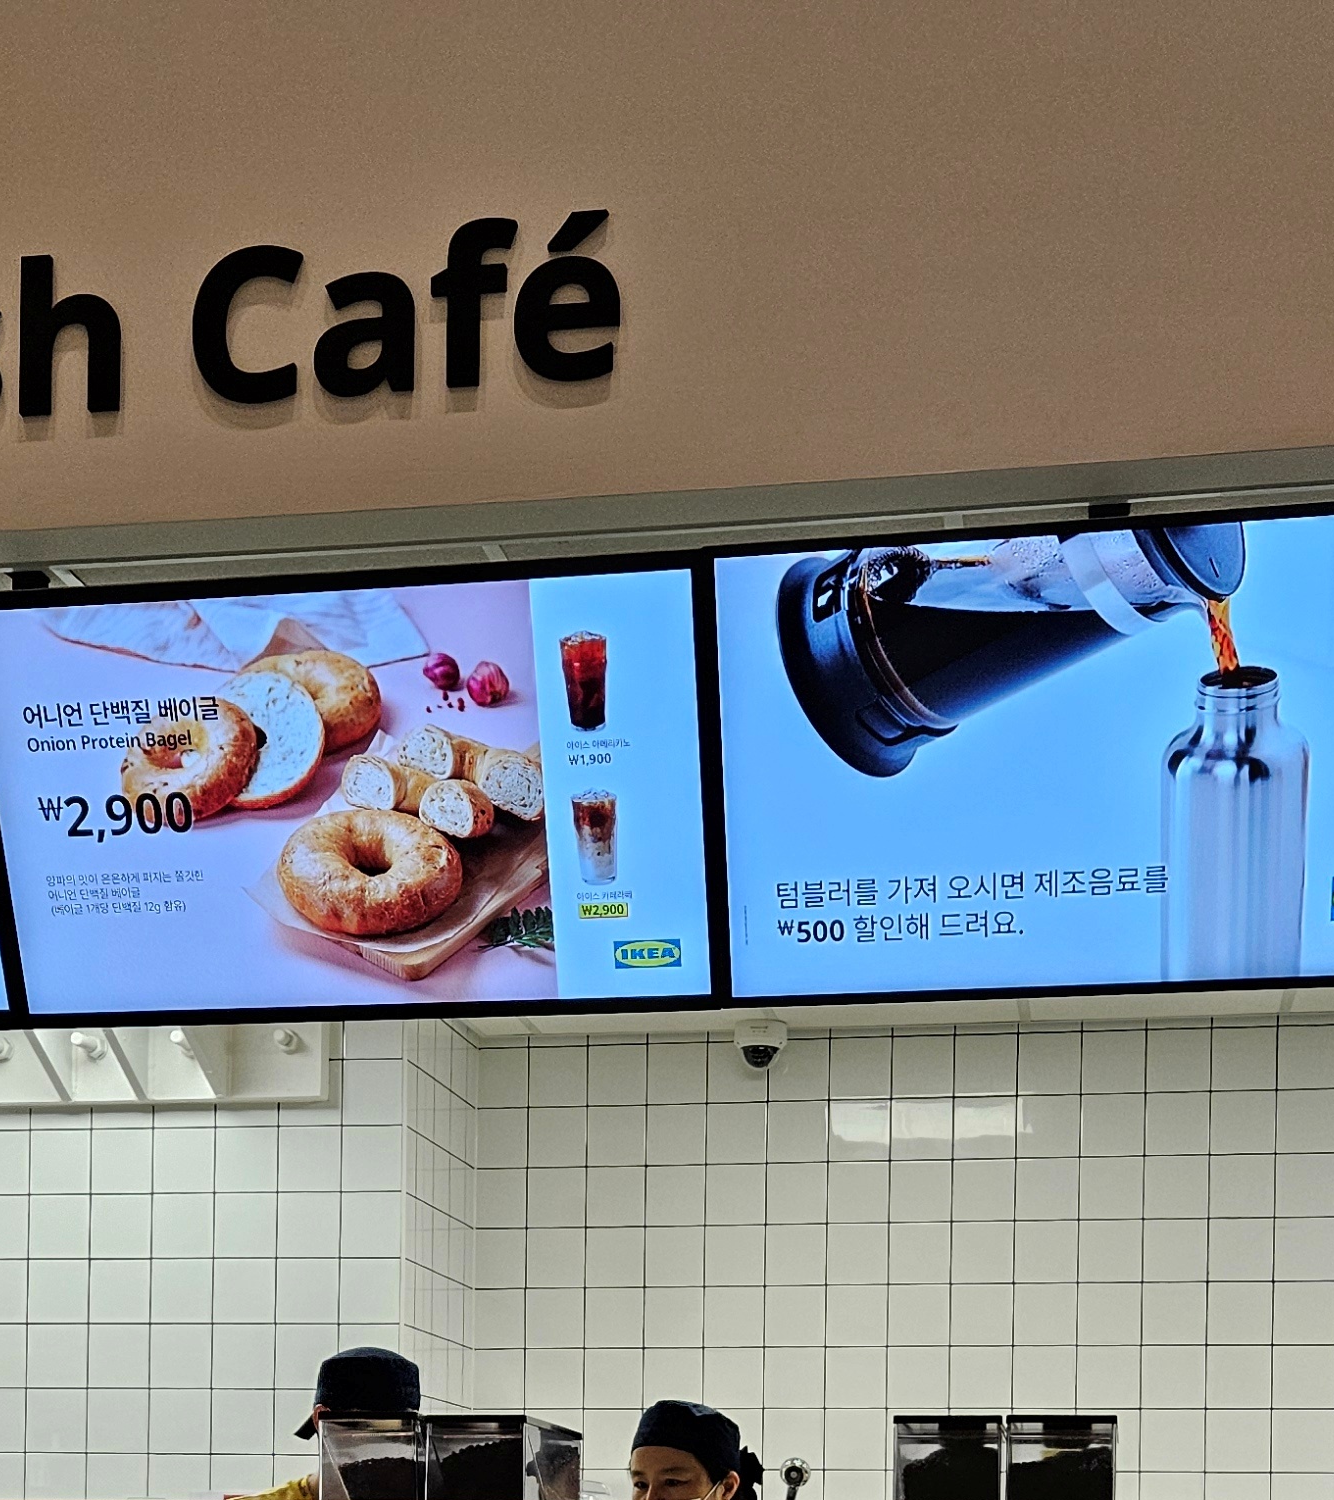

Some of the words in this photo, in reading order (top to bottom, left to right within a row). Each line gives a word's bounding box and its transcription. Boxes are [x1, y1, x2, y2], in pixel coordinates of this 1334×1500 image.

[192, 209, 622, 403] Café
[22, 702, 84, 729] 어니언
[89, 698, 152, 726] 단백질
[157, 696, 219, 722] 베이글
[27, 736, 76, 752] Onion
[81, 733, 141, 750] Protein
[146, 730, 192, 751] Bagel
[568, 753, 611, 766] ₩1,900
[37, 792, 193, 842] ₩2,900
[45, 874, 76, 887] 양파의
[142, 871, 172, 884] 퍼지는
[776, 878, 879, 909] 텀블러를
[888, 875, 937, 904] 가져
[947, 871, 1024, 900] 오시면
[1034, 865, 1168, 898] 제조음료를
[48, 889, 77, 901] 어니언
[79, 888, 108, 900] 단백질
[111, 887, 141, 899] 베이글
[86, 903, 109, 914] 1개당
[111, 902, 142, 914] 단백질
[144, 902, 161, 914] 12g
[164, 900, 186, 912] 함유)
[581, 904, 624, 917] ₩2,900
[777, 919, 845, 943] ₩500
[853, 912, 929, 943] 할인해
[939, 910, 1024, 938] 드려요.
[620, 947, 676, 960] IKEA
